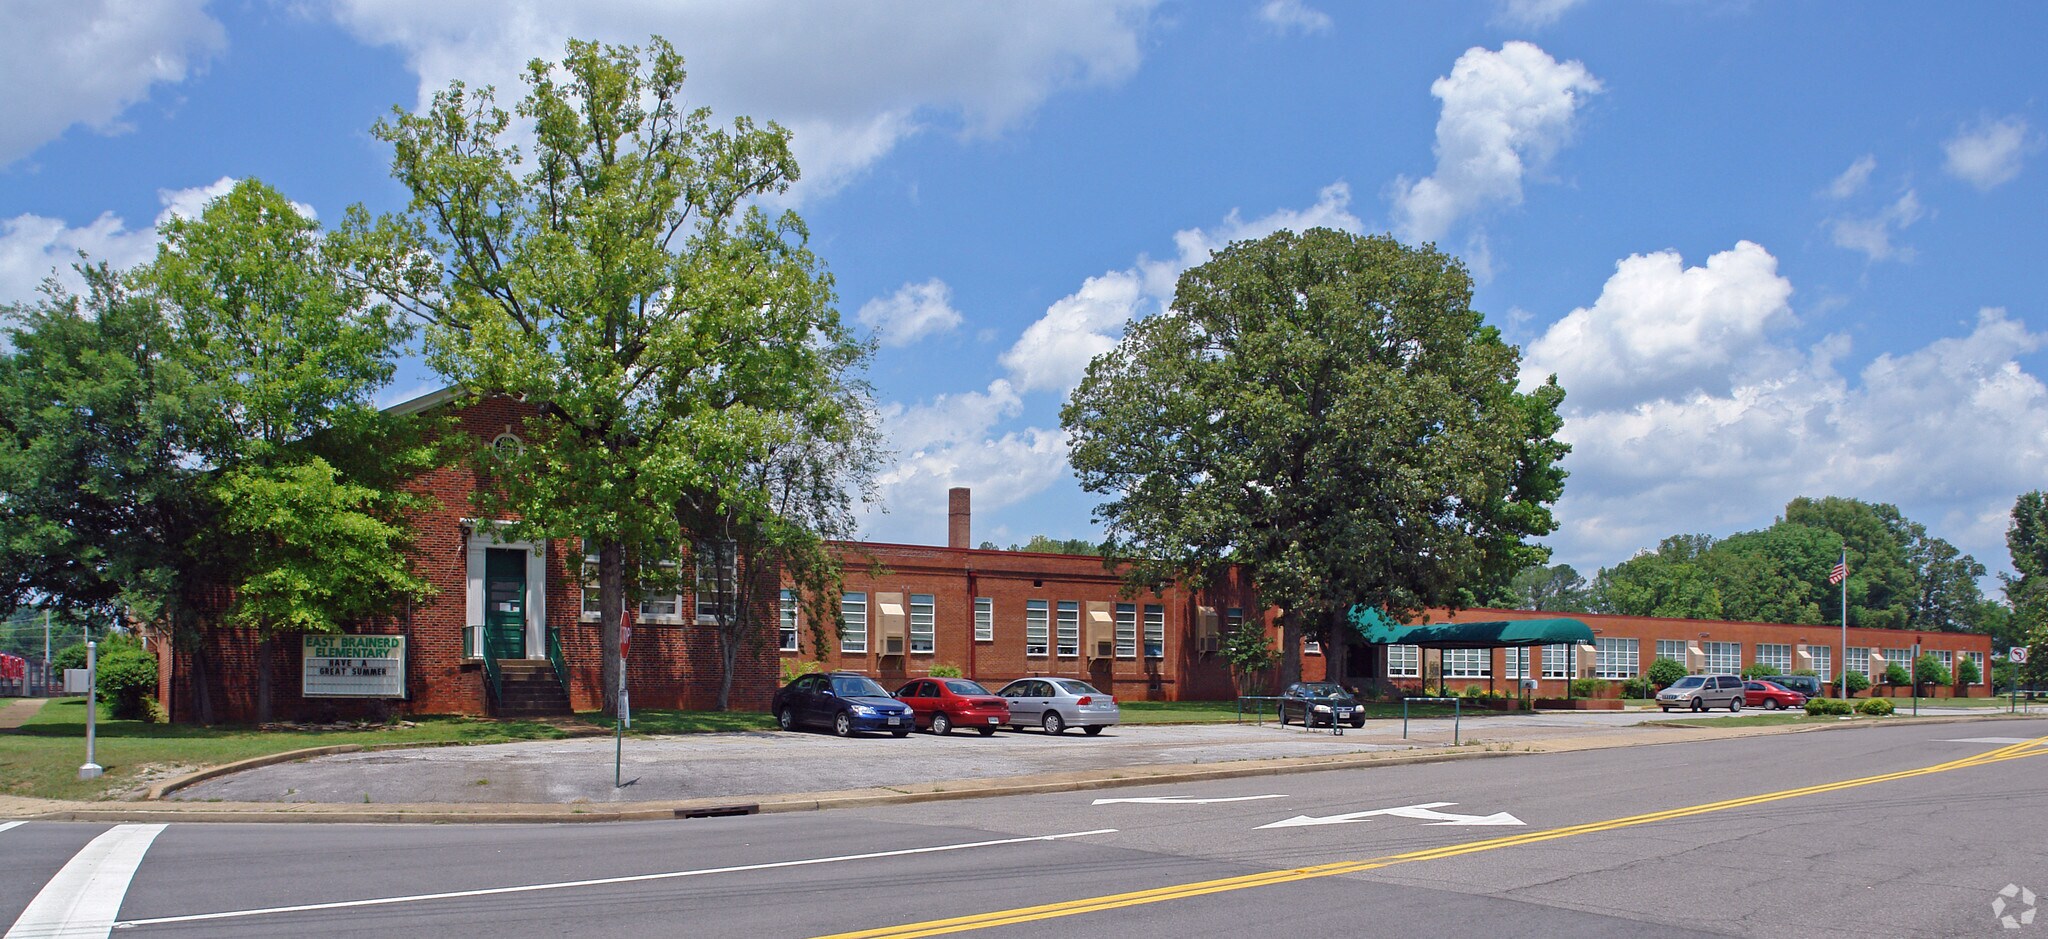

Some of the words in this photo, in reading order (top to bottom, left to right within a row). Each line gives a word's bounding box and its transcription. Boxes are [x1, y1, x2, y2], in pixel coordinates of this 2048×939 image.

[306, 637, 335, 648] EAST
[341, 637, 399, 648] BRAINERD
[315, 647, 390, 658] ELEMENTARY
[329, 659, 352, 667] HAVE
[361, 659, 368, 667] A
[319, 667, 347, 676] GREAT
[352, 667, 387, 676] SUMMER
